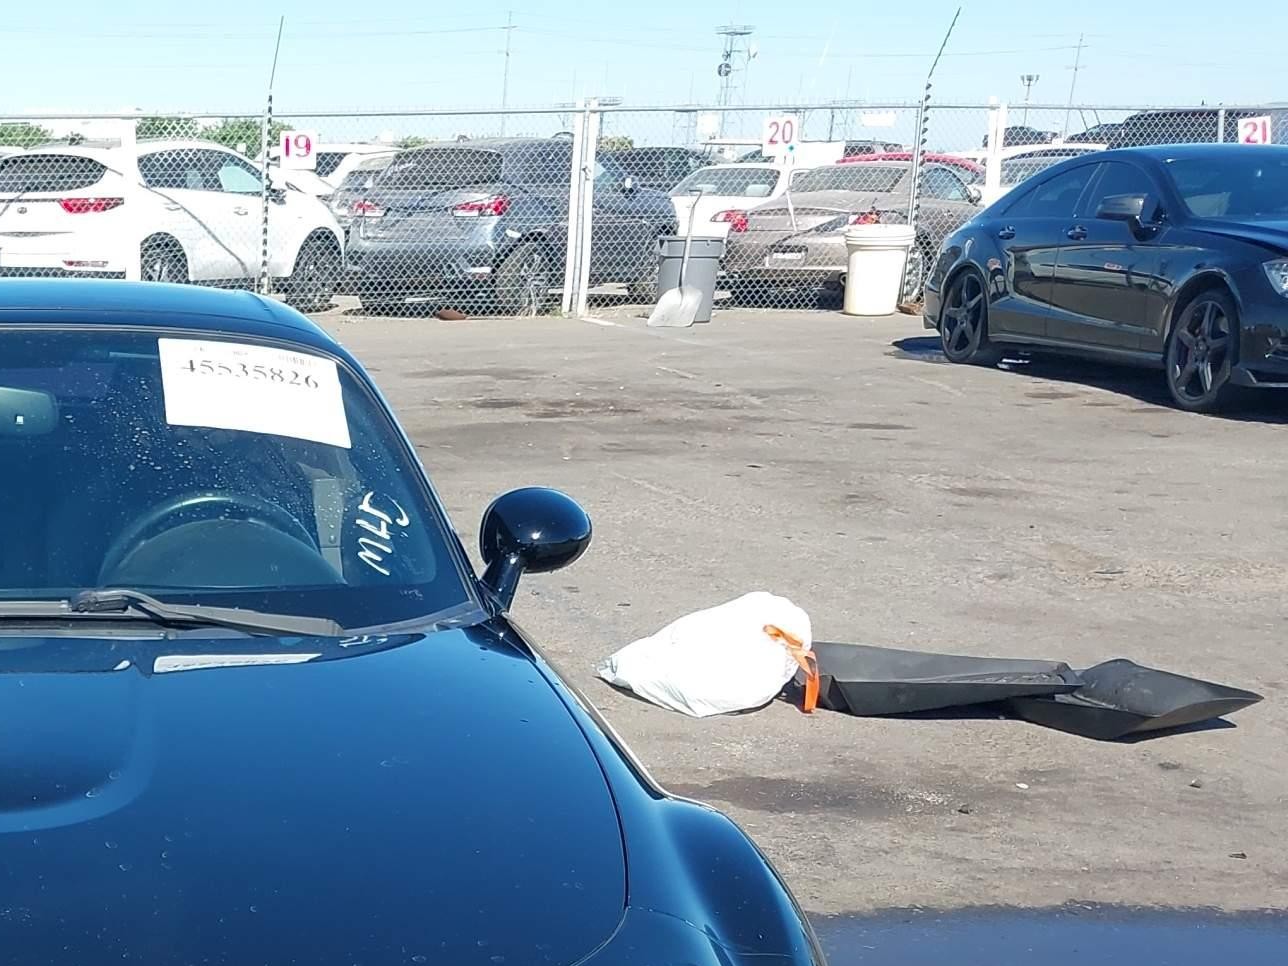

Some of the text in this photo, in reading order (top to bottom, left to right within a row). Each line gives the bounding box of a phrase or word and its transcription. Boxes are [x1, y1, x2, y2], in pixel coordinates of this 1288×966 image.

[767, 120, 794, 145] 20
[1243, 120, 1268, 144] 21
[285, 134, 312, 158] 19
